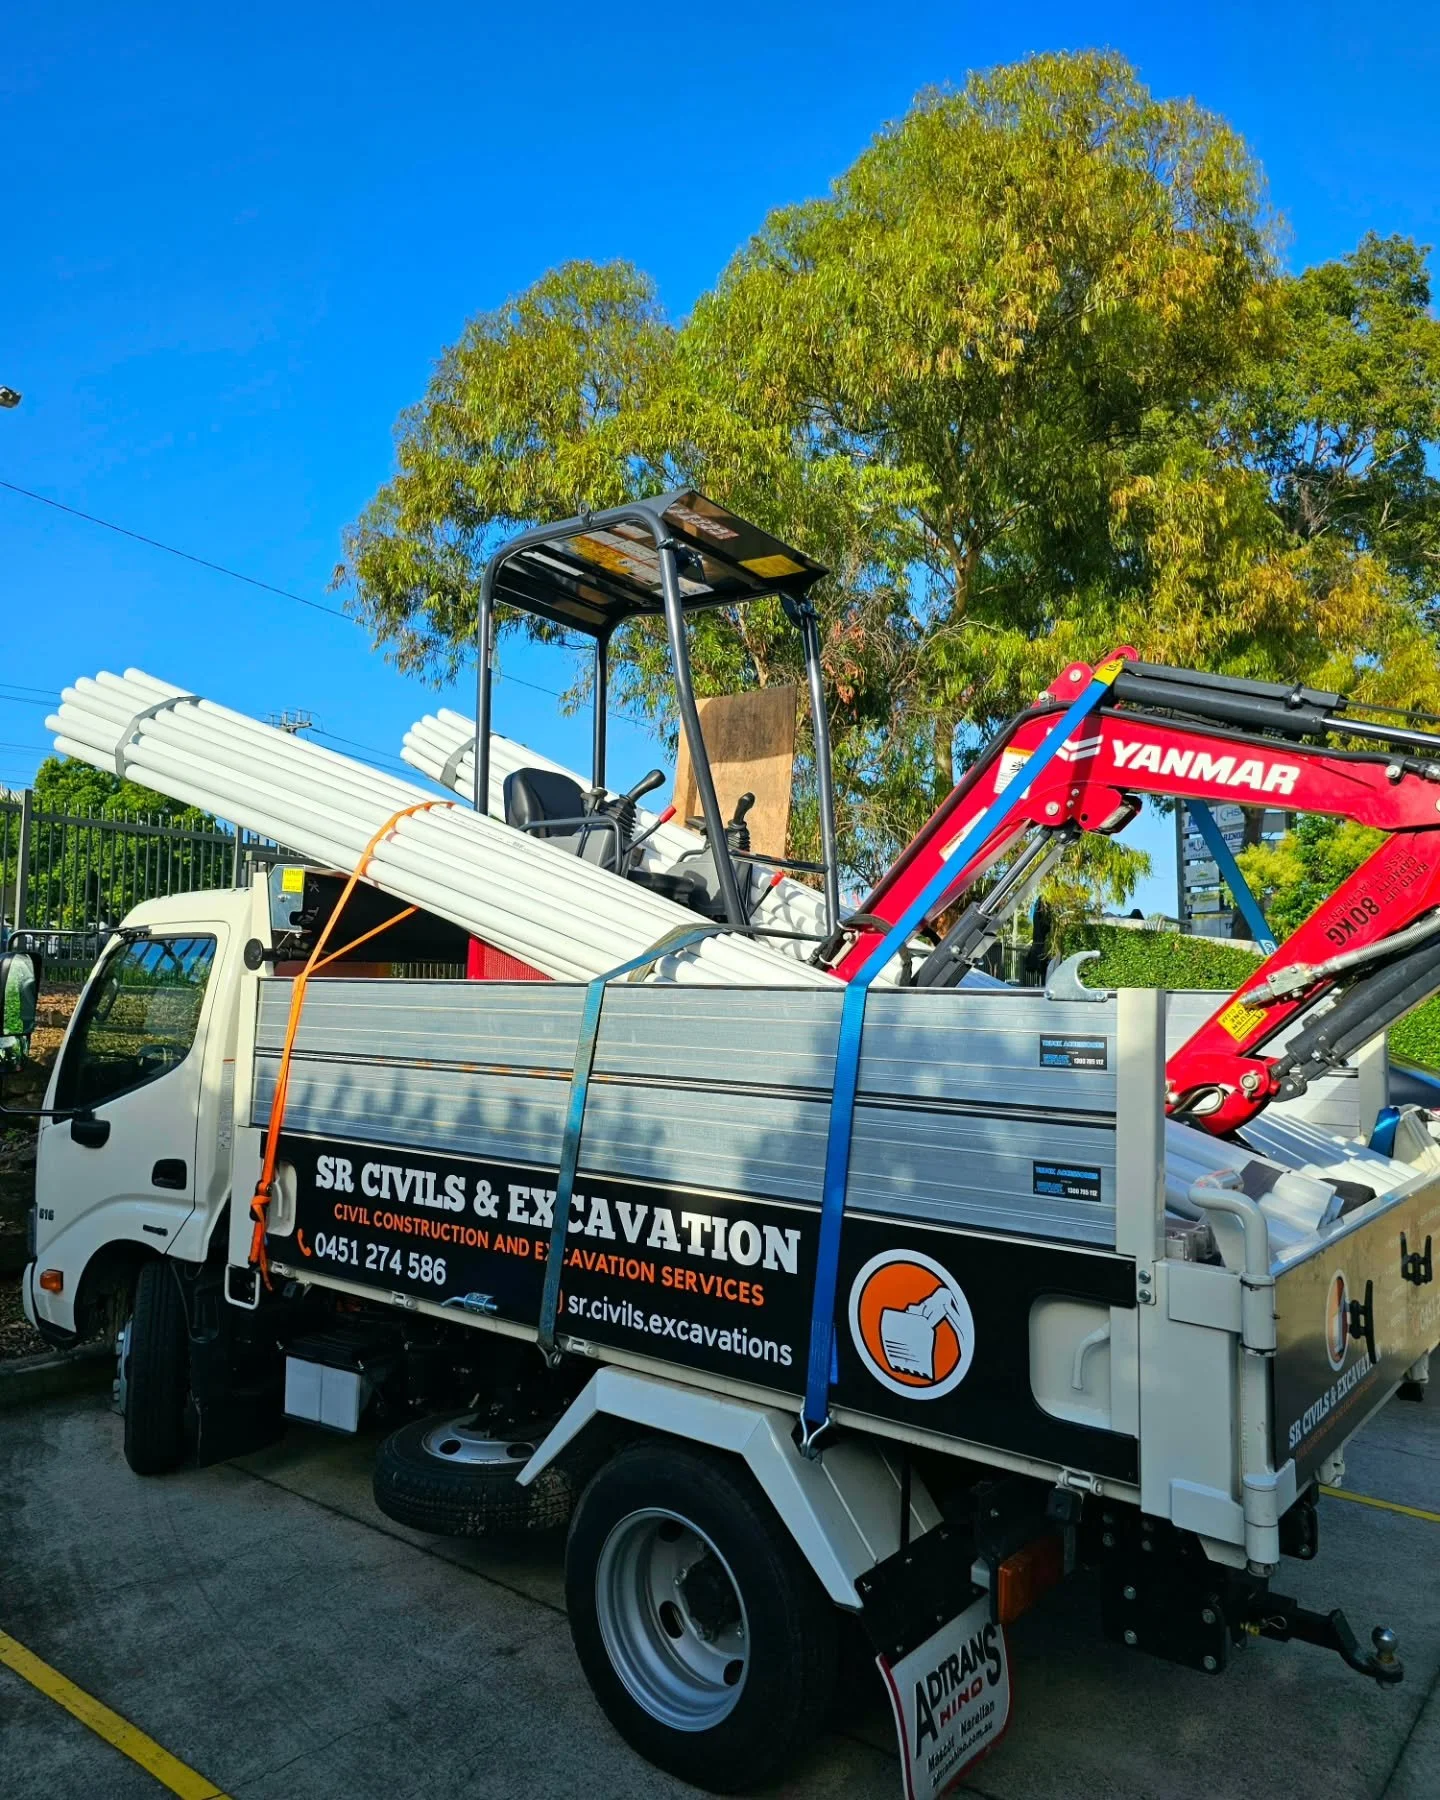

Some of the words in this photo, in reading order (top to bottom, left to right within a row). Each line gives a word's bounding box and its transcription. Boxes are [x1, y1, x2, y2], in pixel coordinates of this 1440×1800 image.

[1112, 739, 1300, 795] YANMAR
[1374, 854, 1417, 894] CAPACITY
[1381, 885, 1401, 904] LIFT
[1398, 860, 1429, 889] RATED
[316, 1155, 355, 1193] SR
[361, 1162, 466, 1213] CIVILS
[473, 1179, 500, 1218] &
[315, 1232, 359, 1266] 0451
[365, 1242, 402, 1275] 274
[407, 1252, 447, 1286] 586
[334, 1202, 370, 1225] CIVIL
[373, 1210, 489, 1249] CONSTRUCTION
[493, 1234, 529, 1257] AND
[535, 1240, 655, 1283] EAVATION
[661, 1265, 765, 1307] SERVICES
[568, 1294, 793, 1366] sr.civils.excavations
[1289, 1419, 1302, 1450] SR
[1303, 1391, 1329, 1434] CIVILS
[914, 1622, 1002, 1760] ADTRANS
[939, 1676, 983, 1728] HINO
[960, 1700, 995, 1737] Narellan
